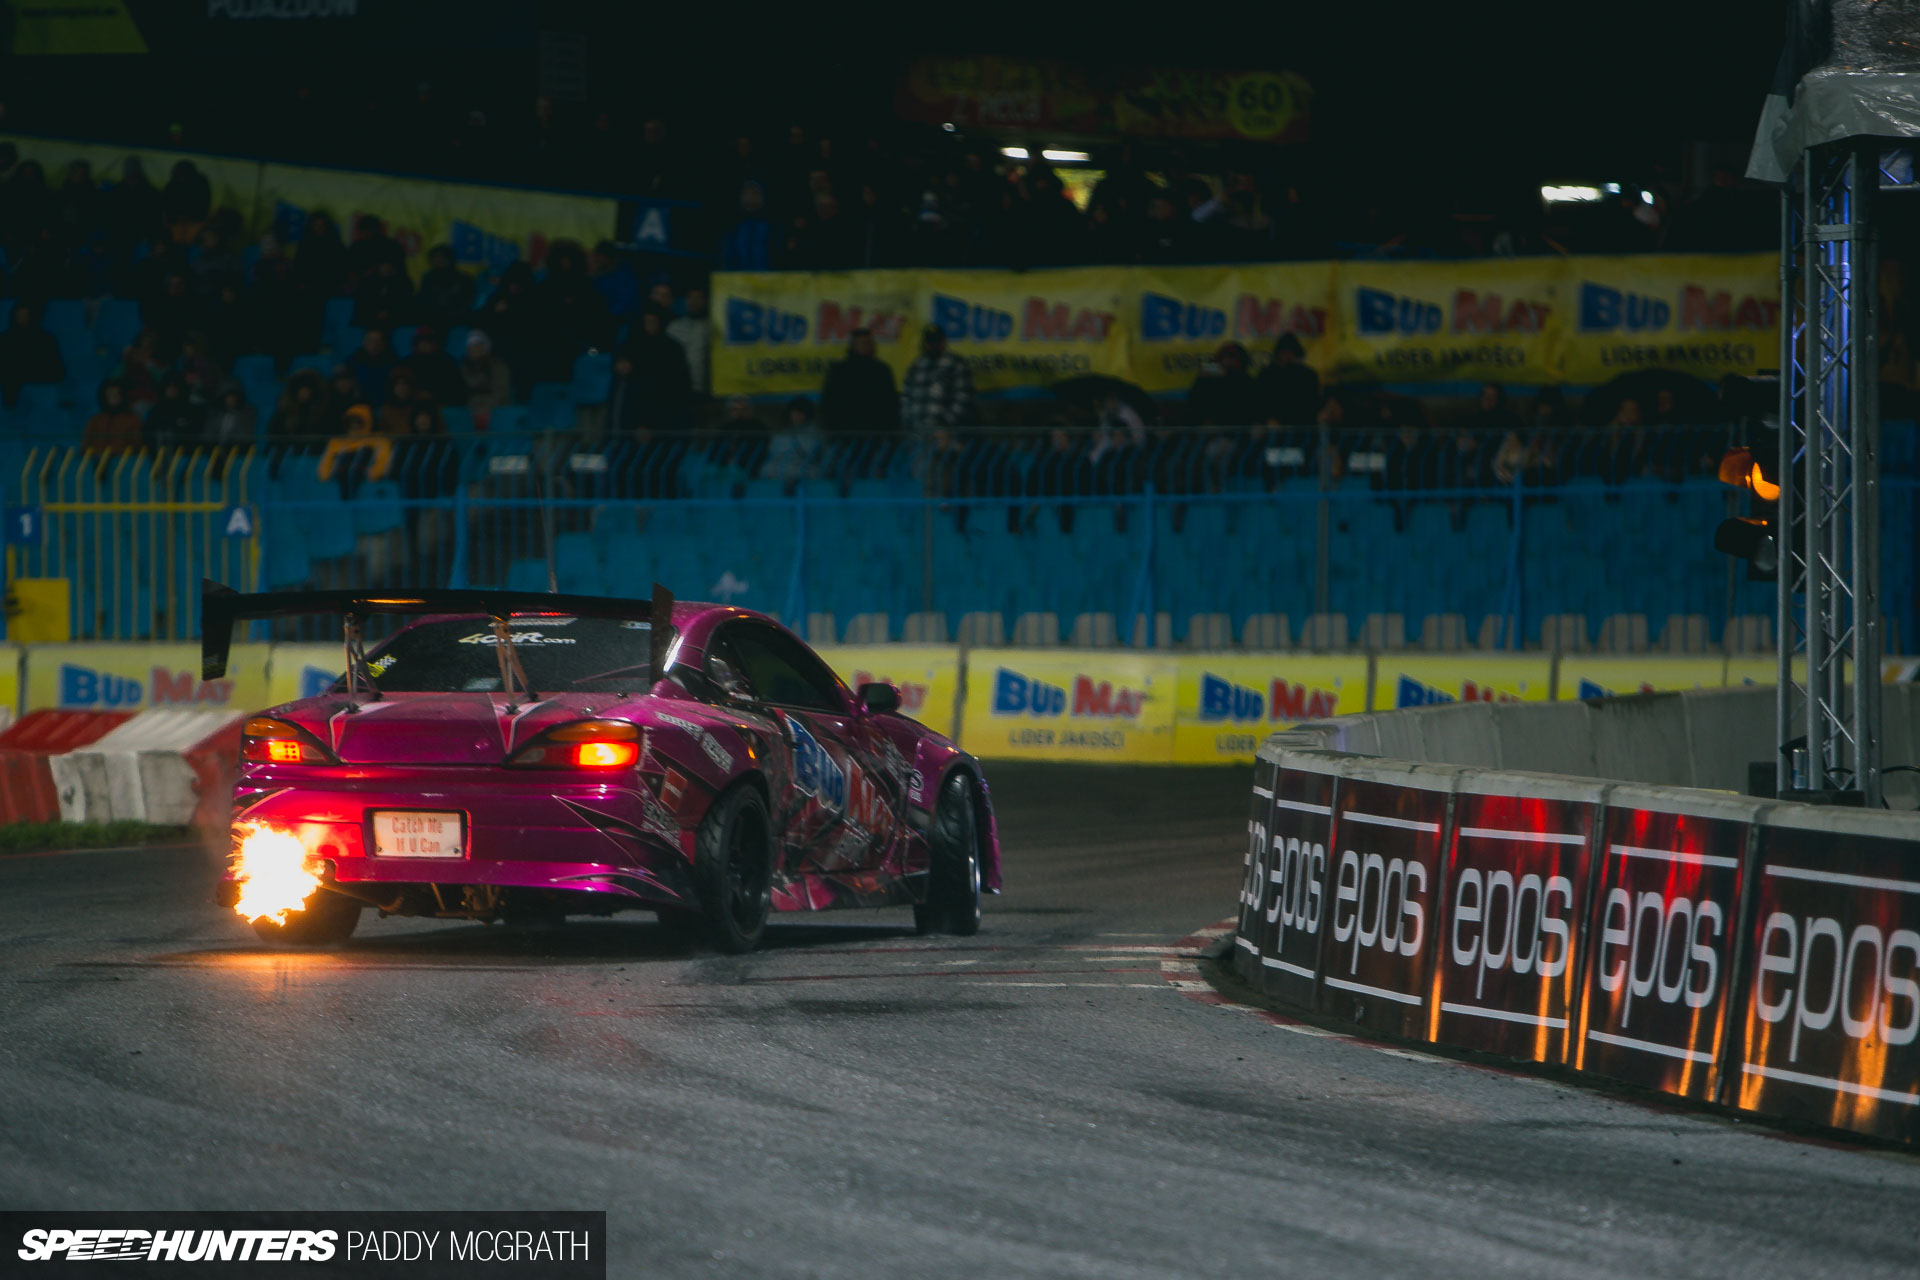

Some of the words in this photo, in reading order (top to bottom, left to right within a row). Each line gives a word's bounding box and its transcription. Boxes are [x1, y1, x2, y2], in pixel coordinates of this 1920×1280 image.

[637, 208, 667, 242] A
[1356, 285, 1444, 336] BUD
[1453, 286, 1551, 334] MAT
[1578, 281, 1671, 333] BUD
[1679, 283, 1779, 332] MAT
[19, 512, 34, 538] 1
[225, 506, 252, 536] A
[60, 662, 145, 708] BUD
[992, 665, 1066, 718] BUD
[1072, 672, 1145, 718] MAT
[1200, 670, 1265, 724] BUD
[1269, 675, 1338, 721] MAT
[1266, 835, 1325, 954] epos
[1334, 850, 1428, 976] epos
[1452, 868, 1574, 1000] epos
[1600, 888, 1723, 1029] epos
[1757, 911, 1920, 1063] epos
